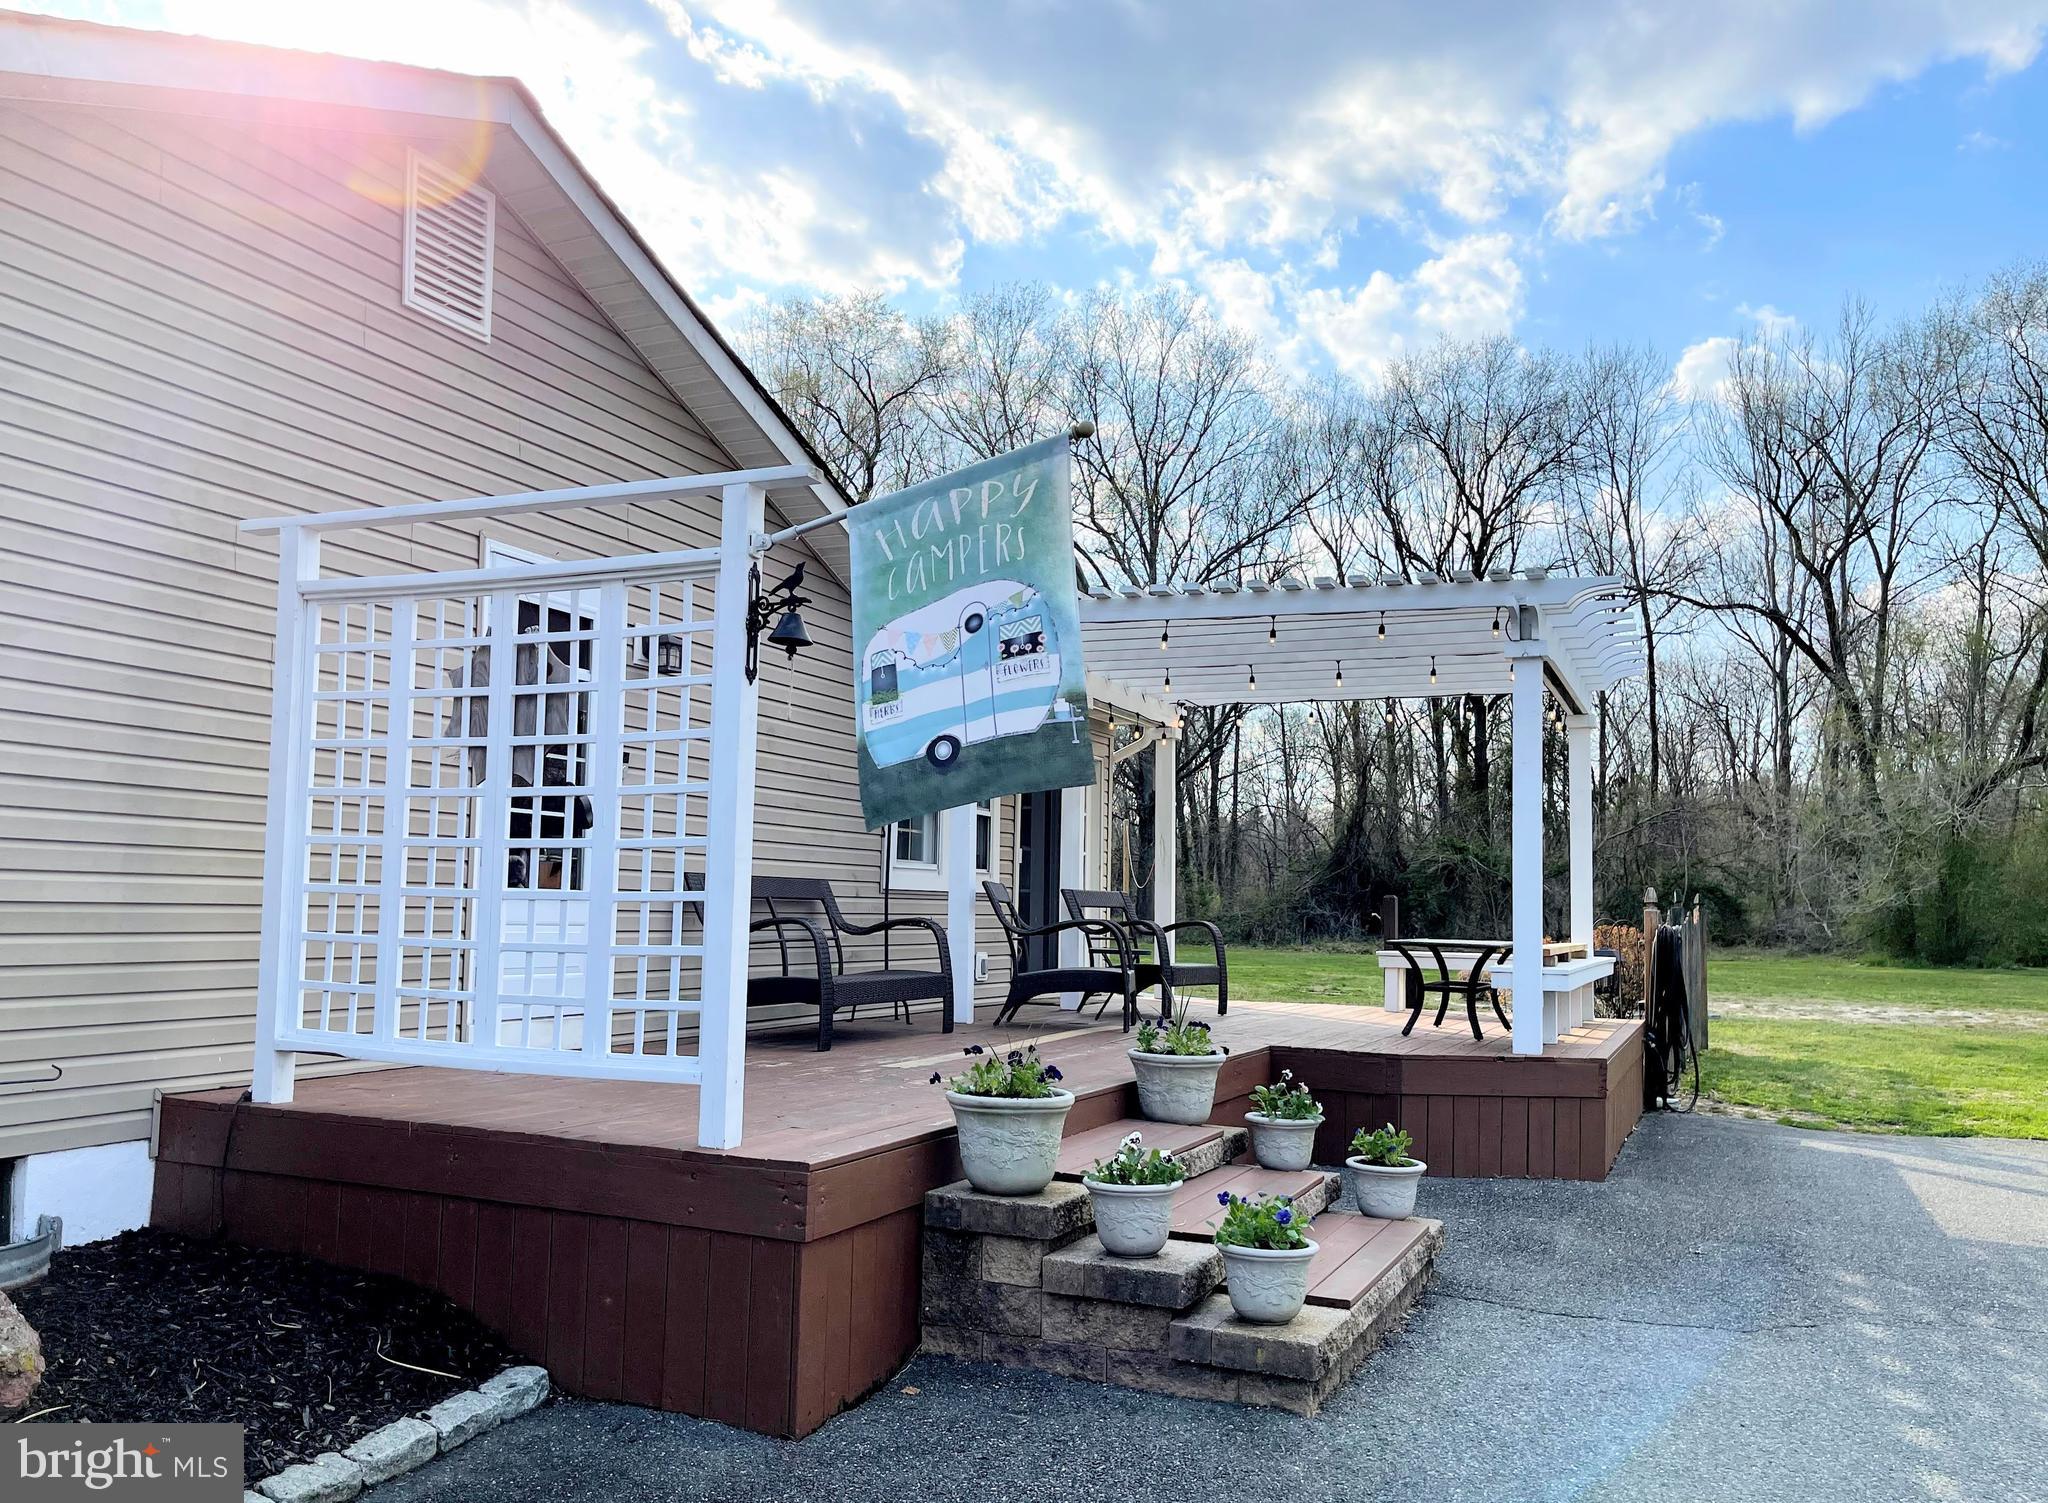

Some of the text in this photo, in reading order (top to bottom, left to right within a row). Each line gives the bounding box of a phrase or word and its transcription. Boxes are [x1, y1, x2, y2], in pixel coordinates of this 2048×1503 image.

[874, 473, 1039, 561] HAPPY
[888, 522, 1025, 600] CAMPERS
[1003, 658, 1044, 676] FLOWERS
